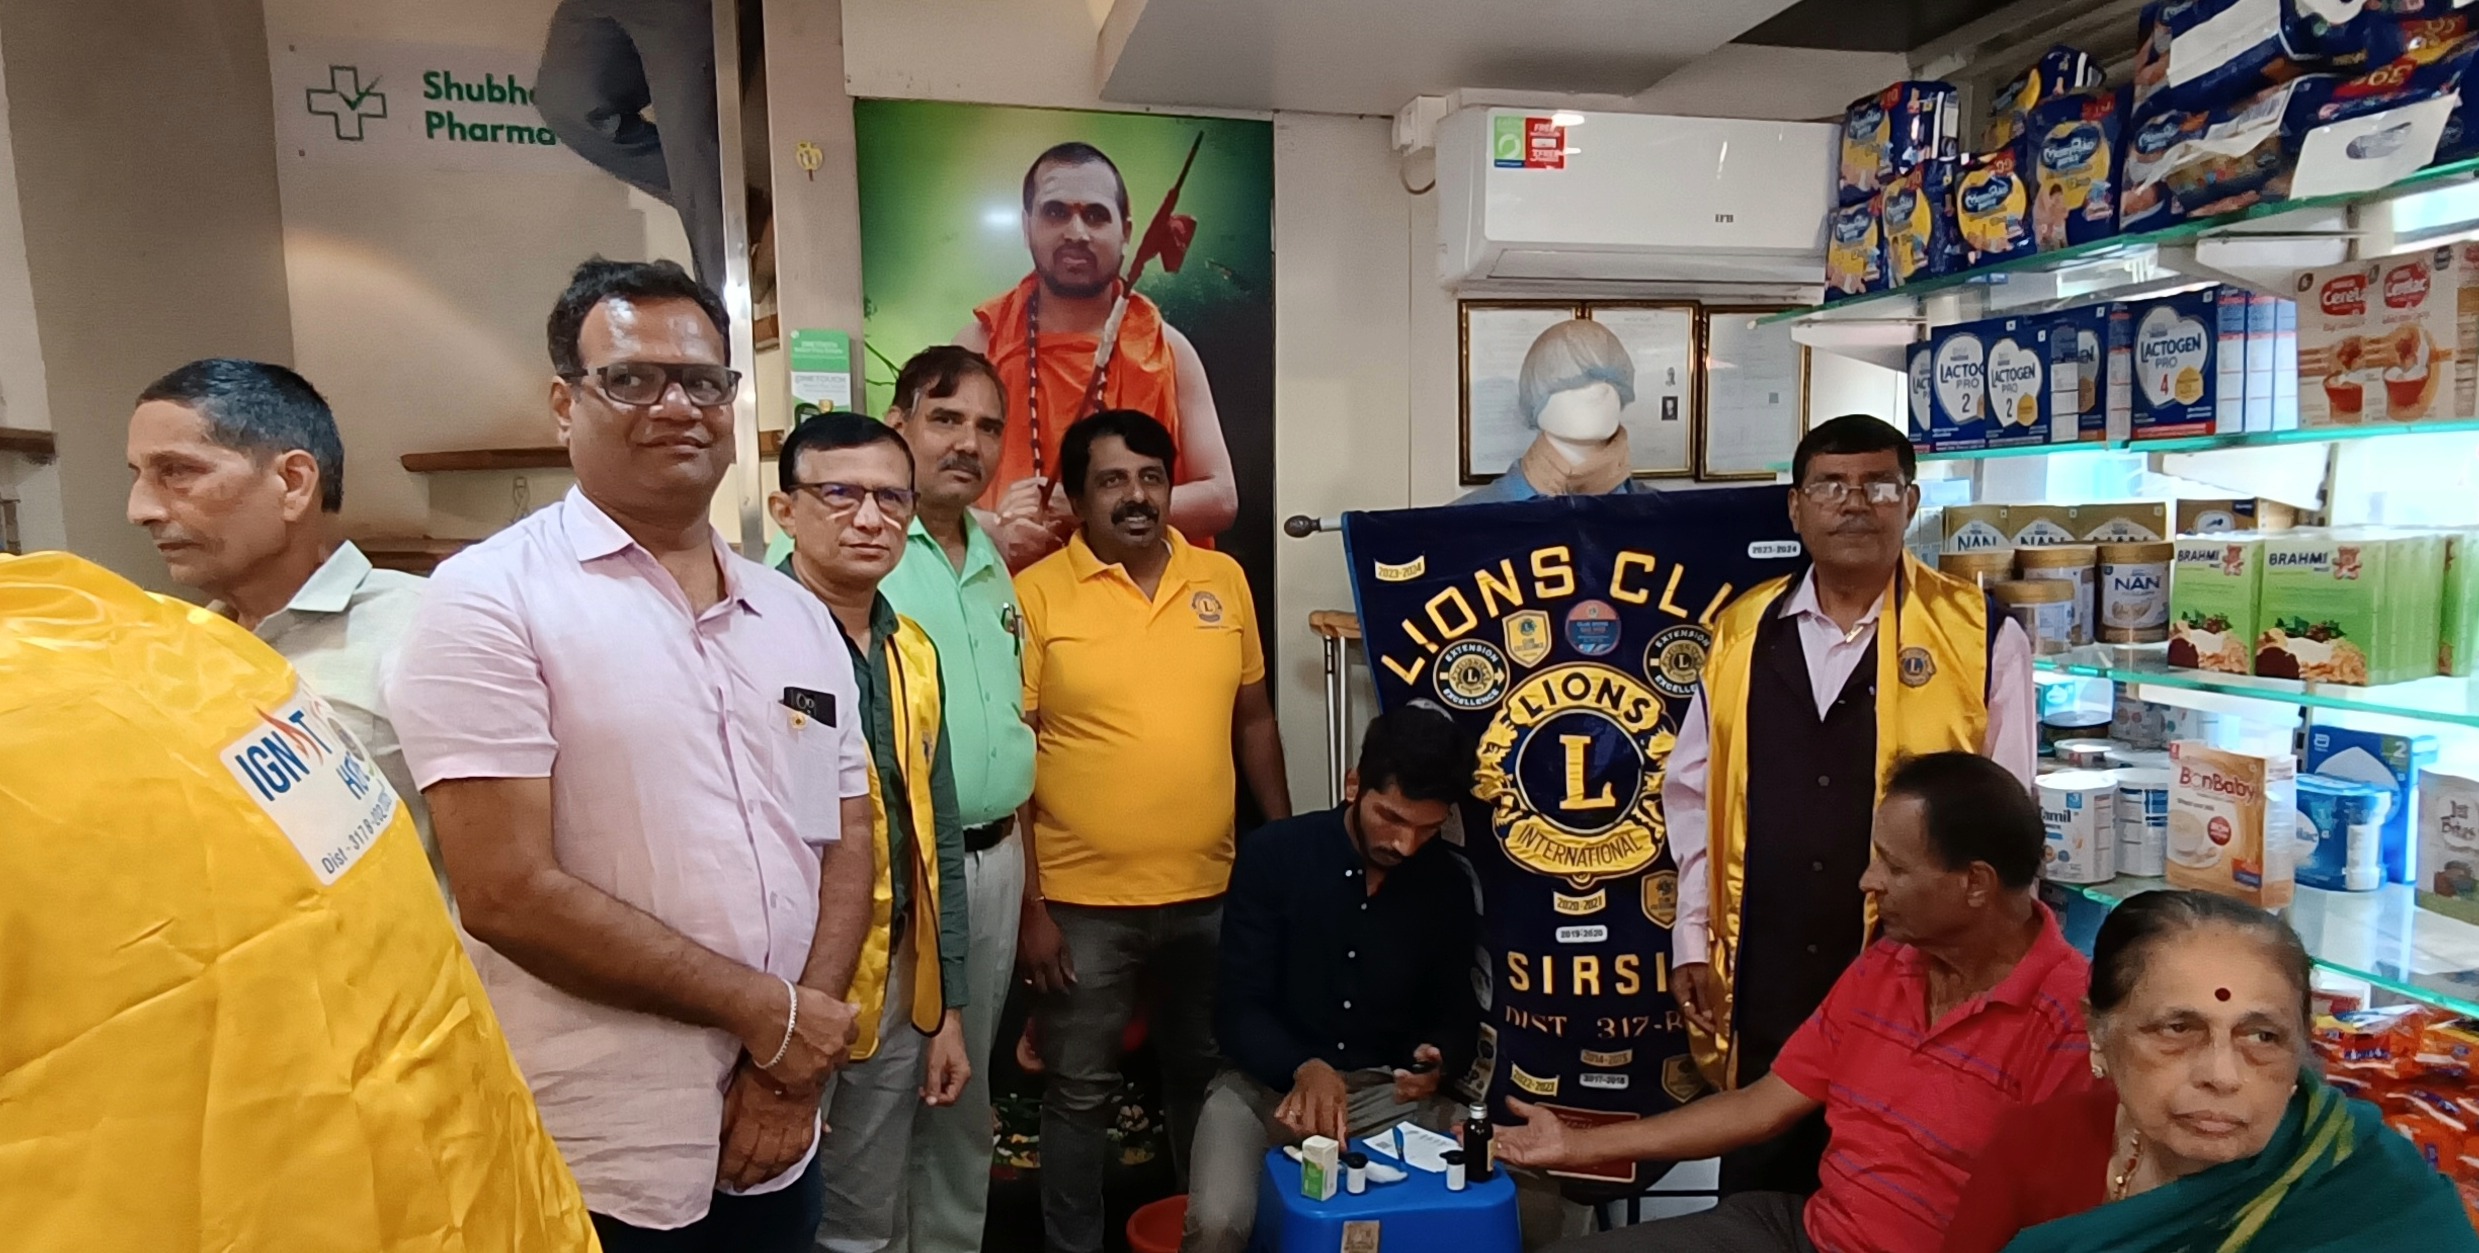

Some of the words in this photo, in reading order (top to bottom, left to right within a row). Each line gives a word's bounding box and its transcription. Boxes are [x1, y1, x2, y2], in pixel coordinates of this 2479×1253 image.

[425, 110, 556, 145] Pharma
[2141, 333, 2201, 362] LACTOGEN
[2155, 356, 2177, 370] PRO
[1956, 379, 1979, 389] PRO
[1991, 362, 2035, 388] LACTOGEN
[2160, 373, 2169, 395] 4
[1962, 393, 1970, 413] 2
[2006, 398, 2013, 418] 2
[2178, 550, 2220, 562] BRAHMI
[2269, 552, 2327, 566] BRAHMI
[2115, 577, 2160, 591] NAN
[1381, 546, 1575, 685] LIONS
[1655, 630, 1710, 648] EXTENSION
[1445, 644, 1499, 662] EXTENSION
[1467, 669, 1478, 682] L
[1443, 688, 1500, 706] EXCELLENCE
[1518, 672, 1652, 724] LIONS
[2393, 741, 2407, 758] 2
[1559, 734, 1616, 810] L
[2180, 766, 2256, 804] BonBaby
[1518, 824, 1643, 868] INTERNATIONAL
[321, 847, 348, 874] Dist
[1507, 951, 1667, 995] SIRSI
[1505, 1005, 1567, 1038] DIST
